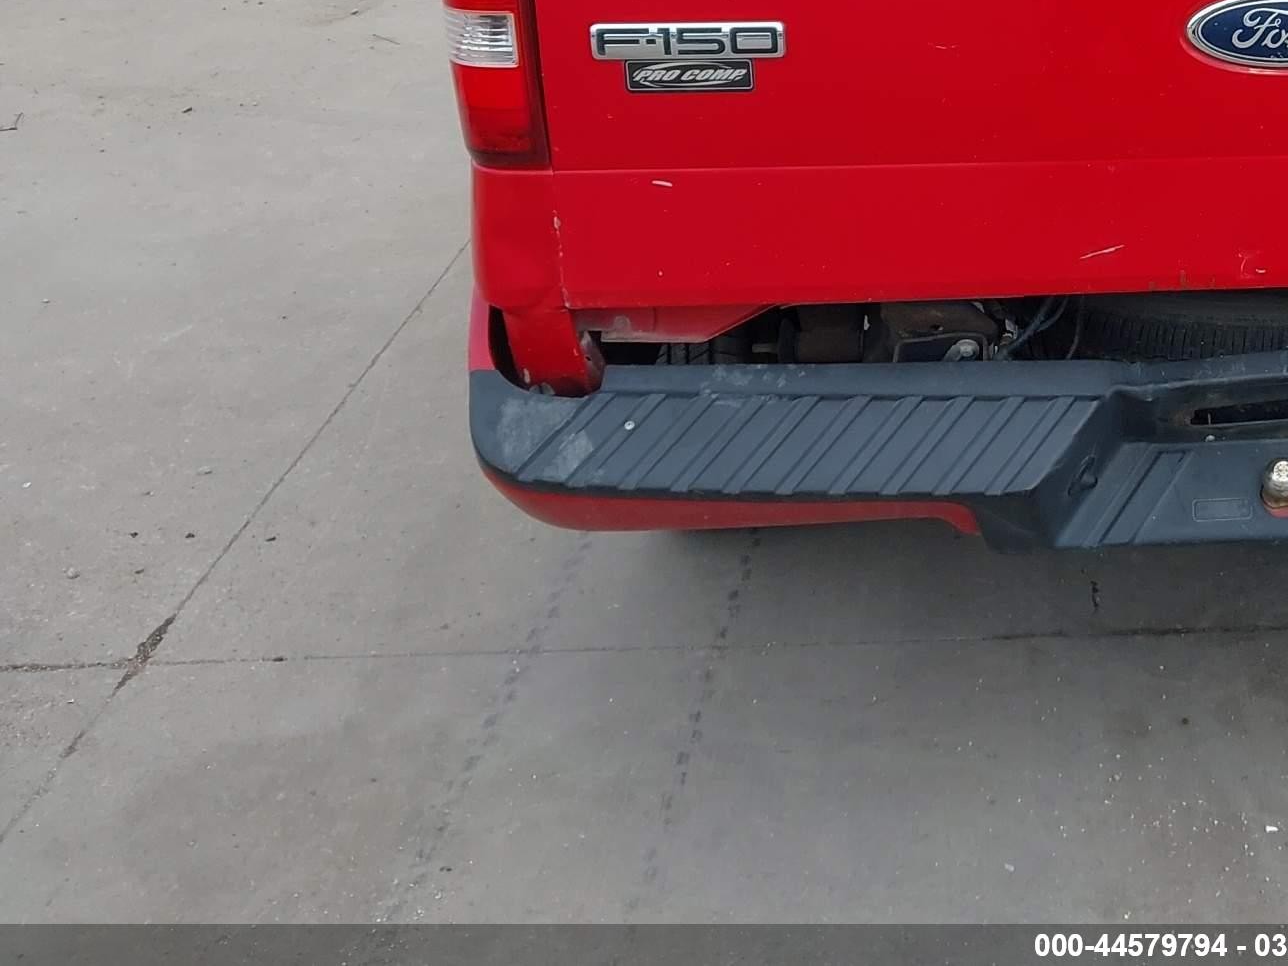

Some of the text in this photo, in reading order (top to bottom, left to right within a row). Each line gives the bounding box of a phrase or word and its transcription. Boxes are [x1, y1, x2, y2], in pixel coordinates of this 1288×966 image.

[596, 26, 778, 55] F-150
[633, 67, 748, 82] PRO COMP
